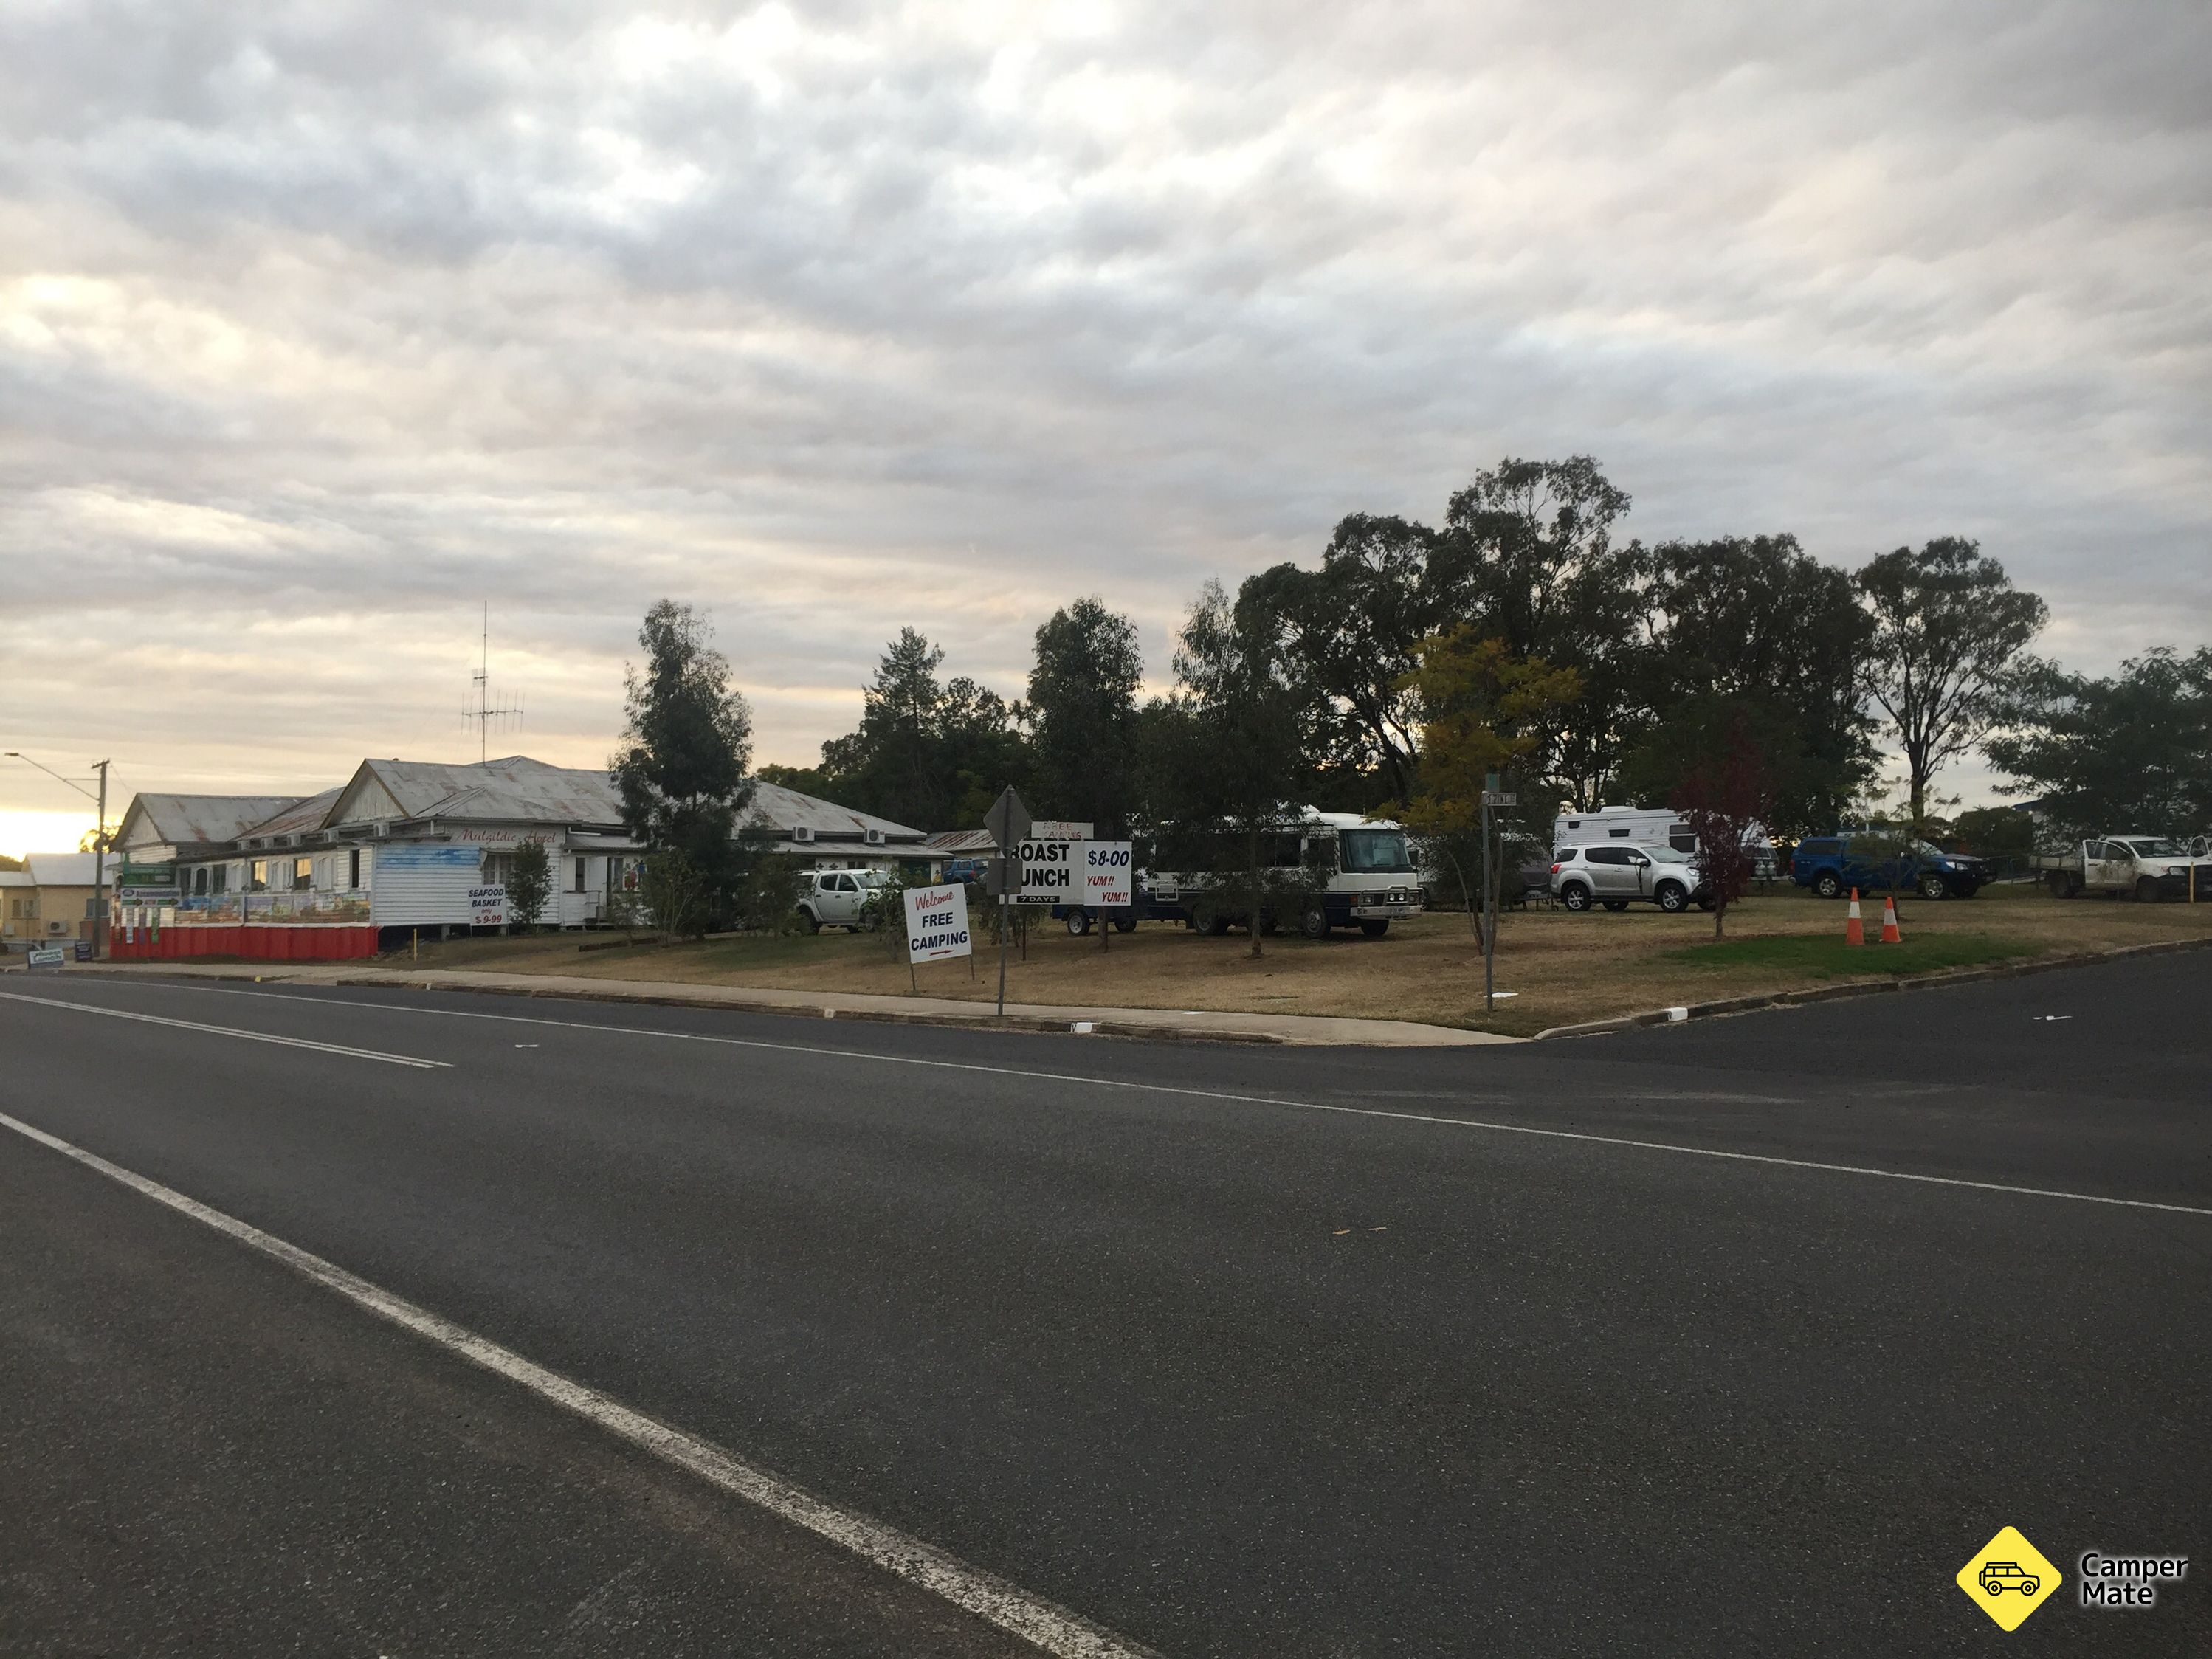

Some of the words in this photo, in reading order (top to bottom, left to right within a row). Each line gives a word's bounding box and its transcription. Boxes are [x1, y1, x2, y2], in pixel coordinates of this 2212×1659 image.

[524, 830, 557, 843] Hotel
[1021, 869, 1069, 886] UNCH
[469, 888, 504, 897] SEAFOOD
[915, 891, 954, 911] Welcome
[472, 899, 503, 908] BASKET
[922, 911, 954, 928] FREE
[911, 931, 968, 951] CAMPING
